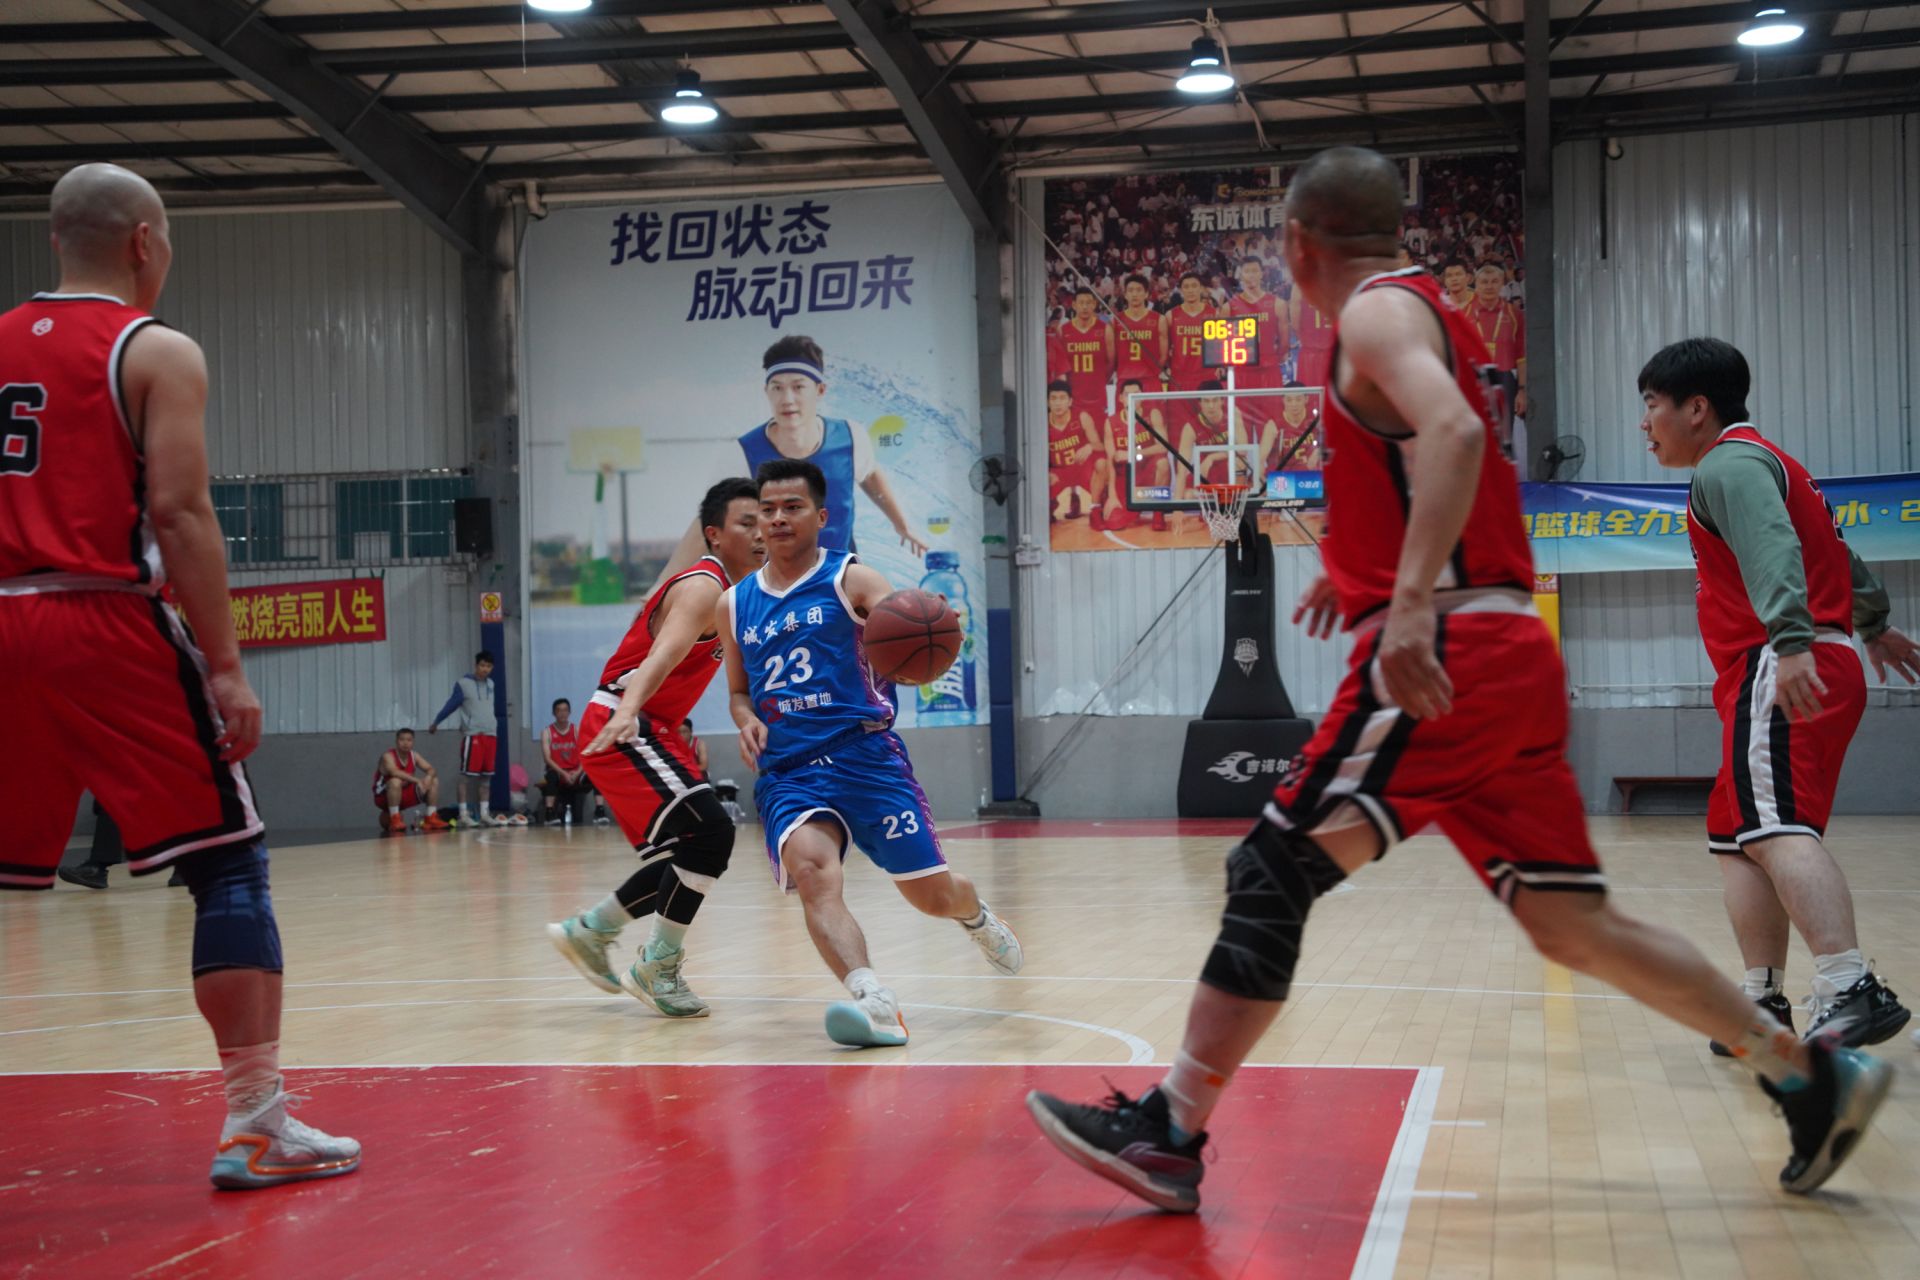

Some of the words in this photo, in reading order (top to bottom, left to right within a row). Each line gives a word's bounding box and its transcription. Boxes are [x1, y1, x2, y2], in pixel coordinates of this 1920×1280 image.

[1190, 203, 1287, 232] 东诚体育
[610, 200, 831, 265] 找回状态
[686, 254, 914, 328] 脉动回来
[1119, 330, 1152, 341] CHINA
[1176, 325, 1202, 335] CHIN
[1203, 318, 1256, 339] 06:19
[1067, 341, 1100, 353] CHINA
[1130, 343, 1141, 361] 9
[1182, 338, 1202, 356] 15
[1222, 338, 1247, 364] 16
[1074, 354, 1094, 372] 10
[0, 383, 48, 477] 6
[878, 433, 903, 448] 维C
[229, 587, 377, 641] 燃烧亮丽人生
[743, 606, 823, 646] 城发集团
[764, 646, 814, 691] 23
[777, 692, 833, 714] 城发置地
[882, 810, 920, 840] 23
